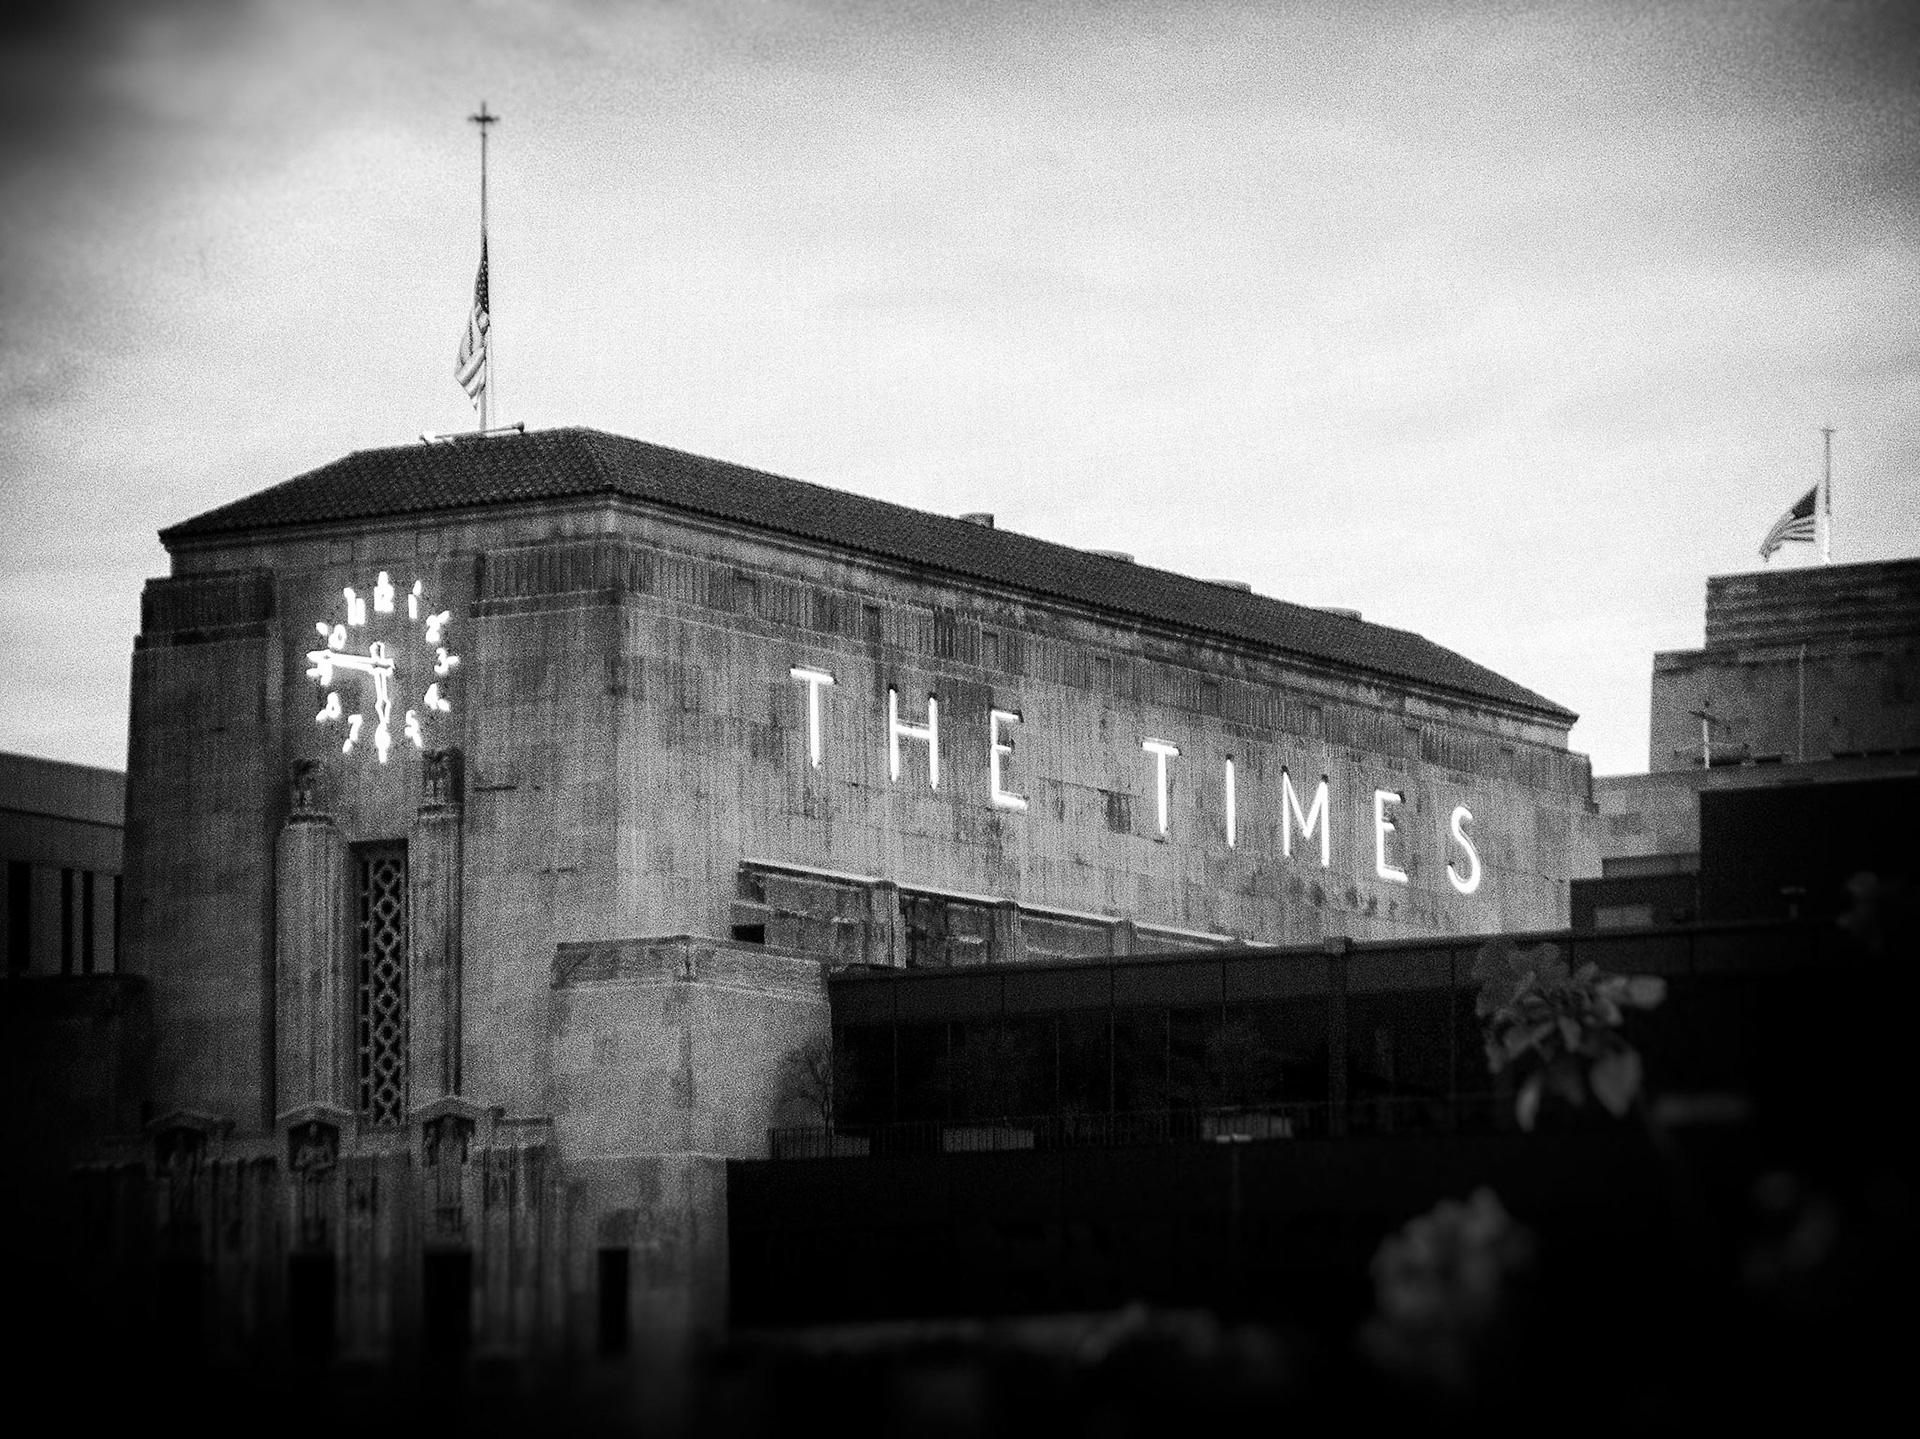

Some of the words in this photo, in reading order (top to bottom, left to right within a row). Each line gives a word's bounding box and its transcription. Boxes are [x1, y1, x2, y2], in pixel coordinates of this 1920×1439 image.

[408, 594, 418, 619] 1
[426, 615, 441, 643] 2
[434, 648, 449, 674] 3
[326, 692, 341, 718] 8
[424, 684, 437, 709] 4
[348, 714, 363, 741] 7
[404, 710, 419, 737] 5
[790, 668, 1028, 810] THE
[1142, 740, 1482, 894] TIMES
